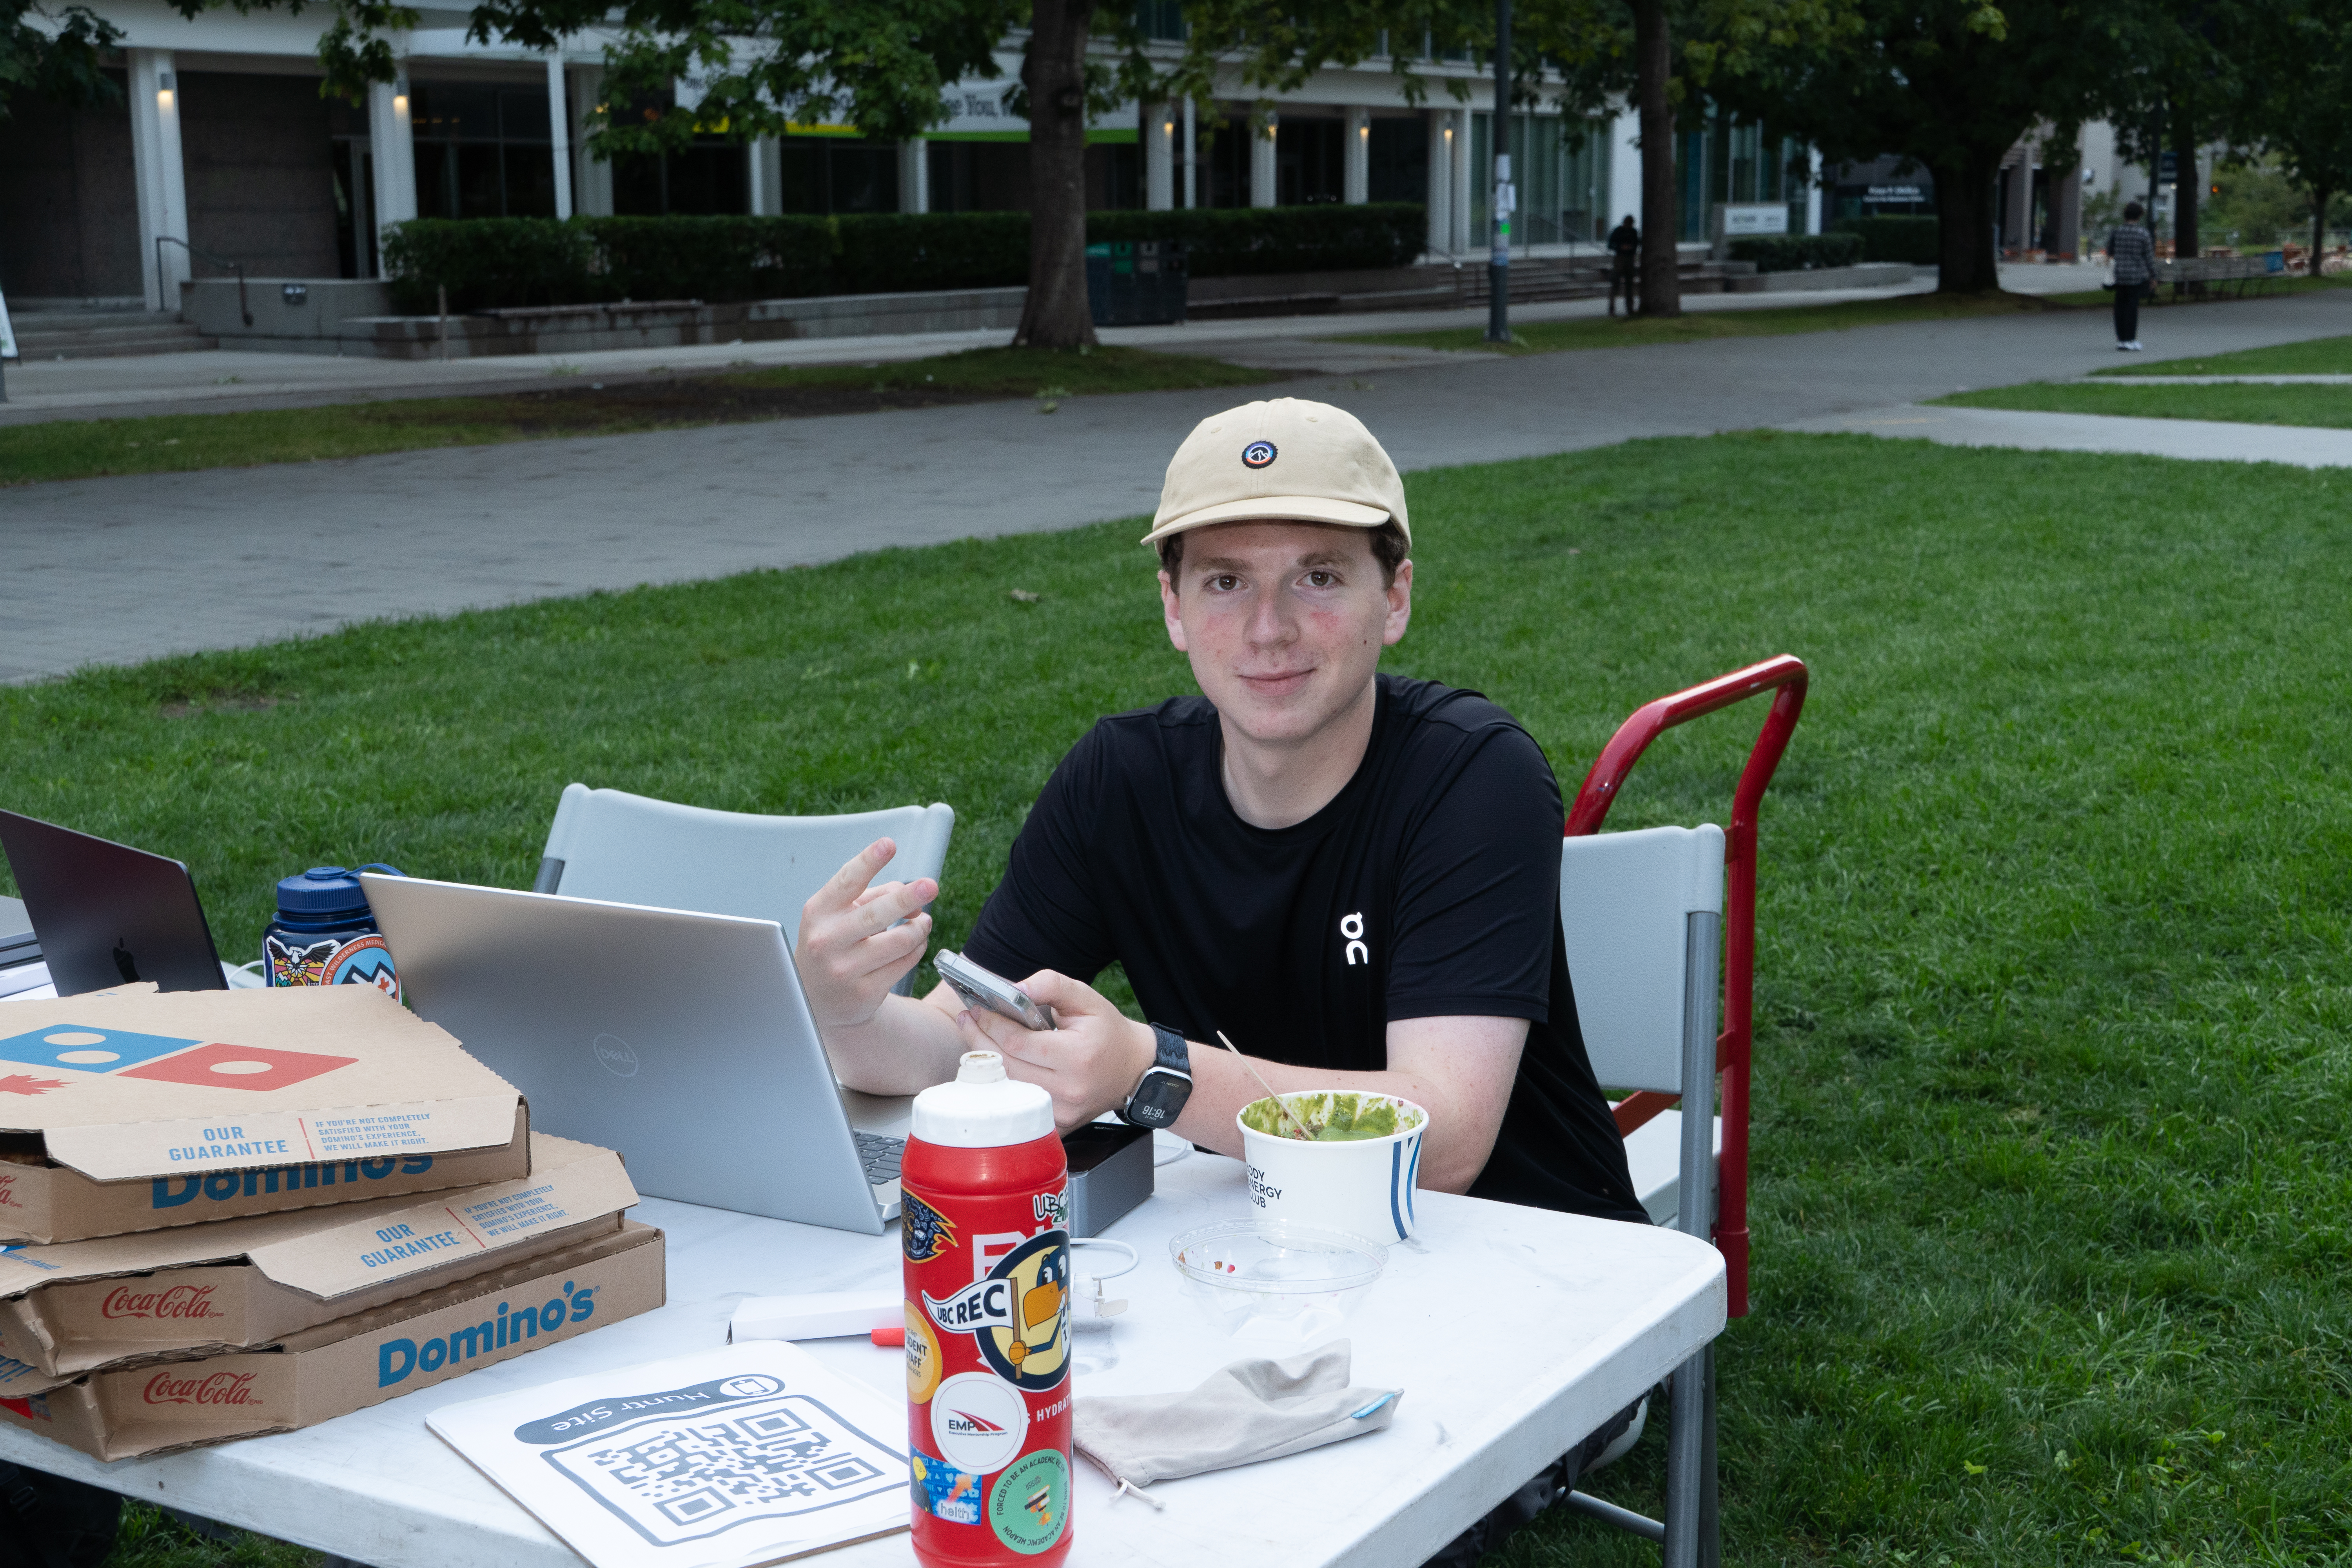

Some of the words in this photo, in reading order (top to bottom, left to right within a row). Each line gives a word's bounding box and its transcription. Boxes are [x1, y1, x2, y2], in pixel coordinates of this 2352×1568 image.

[330, 942, 364, 972] WILDERNESS
[366, 939, 387, 948] MEDICA
[599, 1048, 635, 1063] DELL
[378, 1113, 430, 1123] COMPLETELY
[1142, 1105, 1165, 1119] 18:16
[203, 1127, 245, 1141] OUR
[318, 1127, 361, 1135] SATISFIED
[321, 1134, 364, 1143] DOMINO'S
[366, 1131, 421, 1140] EXPERIENCE,
[169, 1140, 289, 1161] GUARANTEE
[153, 1154, 433, 1209] Dominos
[472, 1200, 499, 1212] YOU'RE
[497, 1196, 510, 1205] NOT
[512, 1184, 554, 1201] COMPLETELY
[1250, 1188, 1266, 1208] LUB
[472, 1207, 507, 1221] SATISFIED
[506, 1202, 526, 1212] WITH
[524, 1197, 545, 1207] YOUR
[479, 1215, 515, 1229] DOMINO'S
[513, 1203, 559, 1220] EXPERIENCE,
[499, 1223, 519, 1233] WILL
[517, 1218, 539, 1229] MAKE
[546, 1209, 569, 1220] RIGHT.
[376, 1224, 416, 1243] OUR
[360, 1231, 461, 1268] GUARANTEE
[102, 1285, 218, 1319] Coca-Cola
[937, 1307, 954, 1325] UBC
[956, 1284, 1007, 1324] REC
[378, 1280, 595, 1388] Domino's
[143, 1372, 258, 1405] Coca-Cola
[621, 1392, 711, 1410] Huntr
[1037, 1392, 1072, 1422] HYDRATI
[551, 1406, 613, 1431] Site
[949, 1419, 975, 1431] EMP
[996, 1489, 1007, 1516] FORCED
[1003, 1479, 1012, 1488] TO
[1010, 1471, 1020, 1481] BE
[1020, 1464, 1029, 1474] AN
[1029, 1456, 1056, 1468] ACADEMIC
[1055, 1459, 1065, 1474] VICTIM
[941, 1503, 969, 1520] helth
[1062, 1501, 1067, 1510] TO
[1054, 1522, 1061, 1532] AN
[1059, 1512, 1065, 1521] BE
[1002, 1525, 1027, 1546] WEAPON
[1027, 1530, 1055, 1546] ACADEMIC
